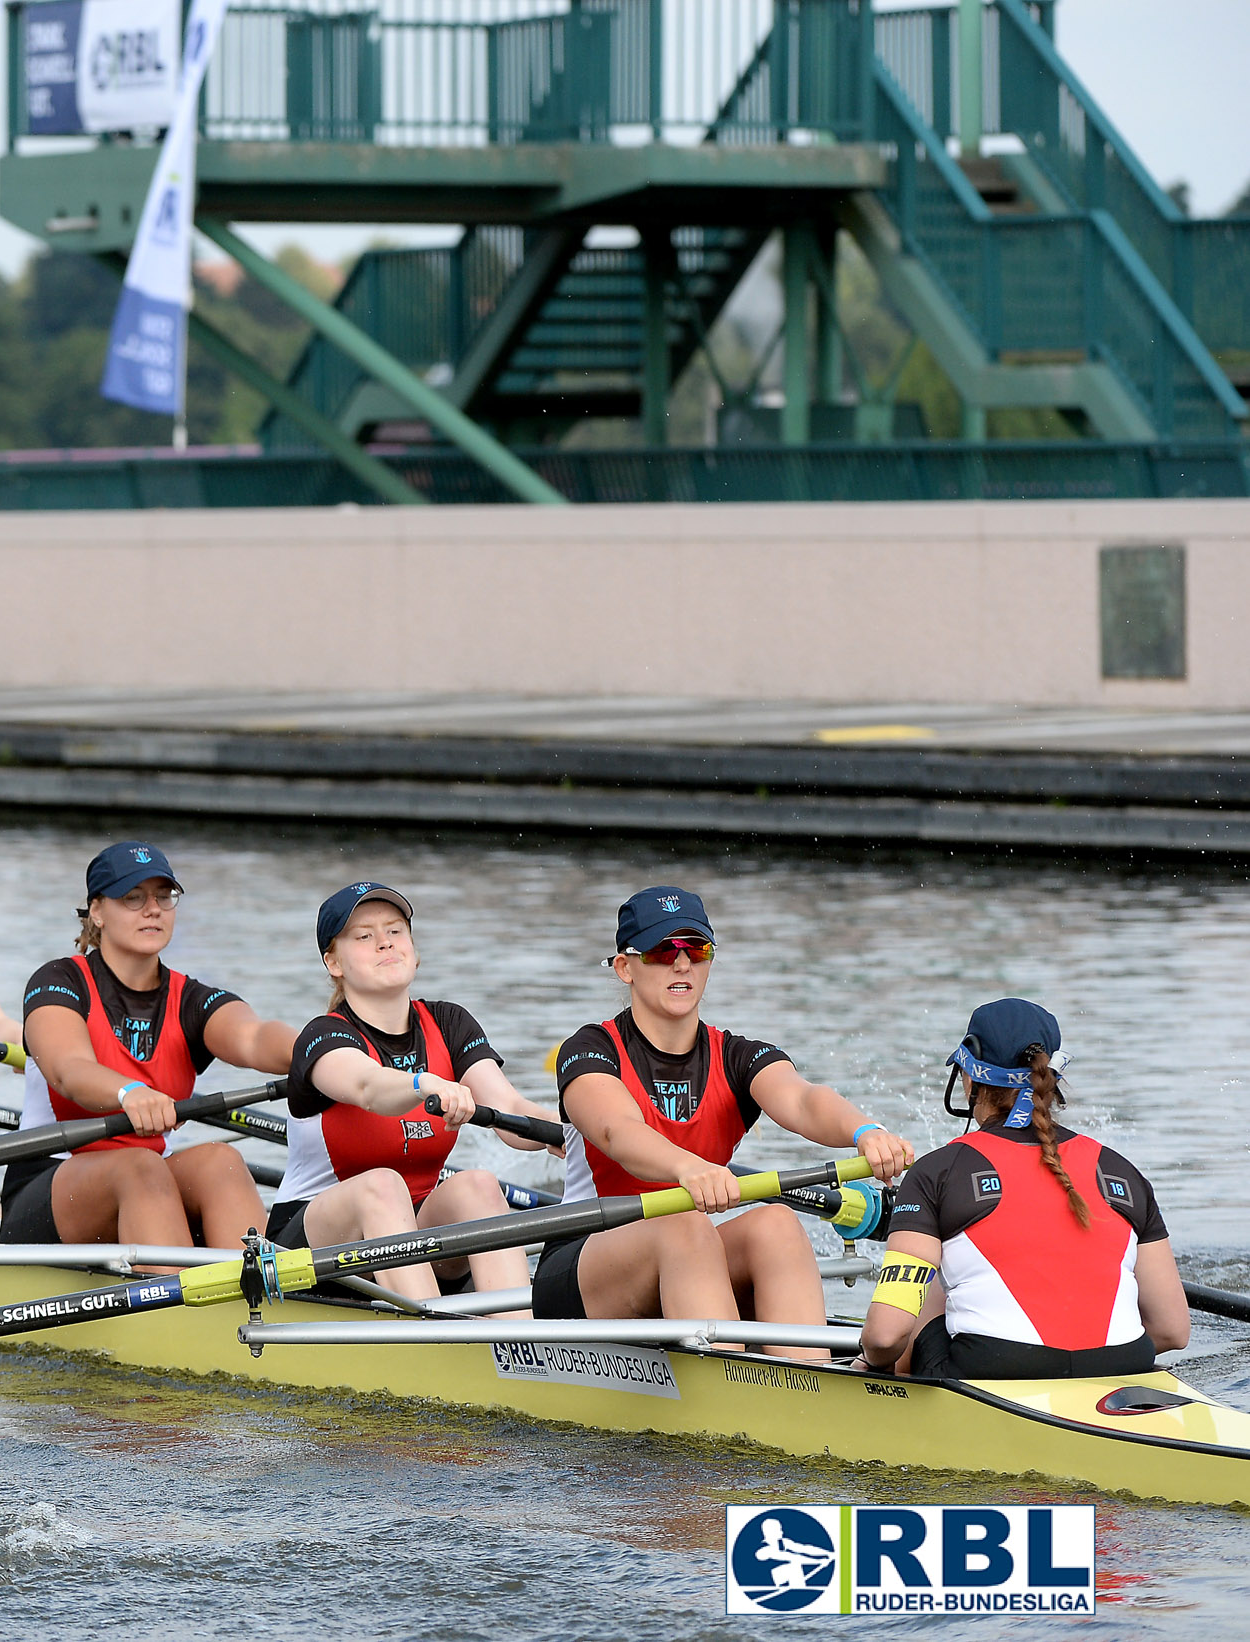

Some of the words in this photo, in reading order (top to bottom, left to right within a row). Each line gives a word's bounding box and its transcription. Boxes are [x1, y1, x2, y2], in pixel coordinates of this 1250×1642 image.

[972, 1063, 992, 1081] NK
[1006, 1071, 1032, 1084] NK
[654, 1083, 688, 1095] TEAM
[245, 1115, 286, 1133] concept
[981, 1178, 1001, 1192] 20
[1109, 1182, 1125, 1197] 18
[818, 1193, 826, 1203] 2
[361, 1239, 424, 1259] concept
[426, 1237, 437, 1247] 2
[1, 1300, 80, 1322] SCHNELL.
[81, 1293, 120, 1311] GUT.
[139, 1285, 170, 1300] RBL
[510, 1343, 545, 1367] RBL
[544, 1346, 676, 1388] RUDER-BUNDESLIGA
[784, 1367, 821, 1393] Hassia
[864, 1382, 910, 1399] EMPACHER
